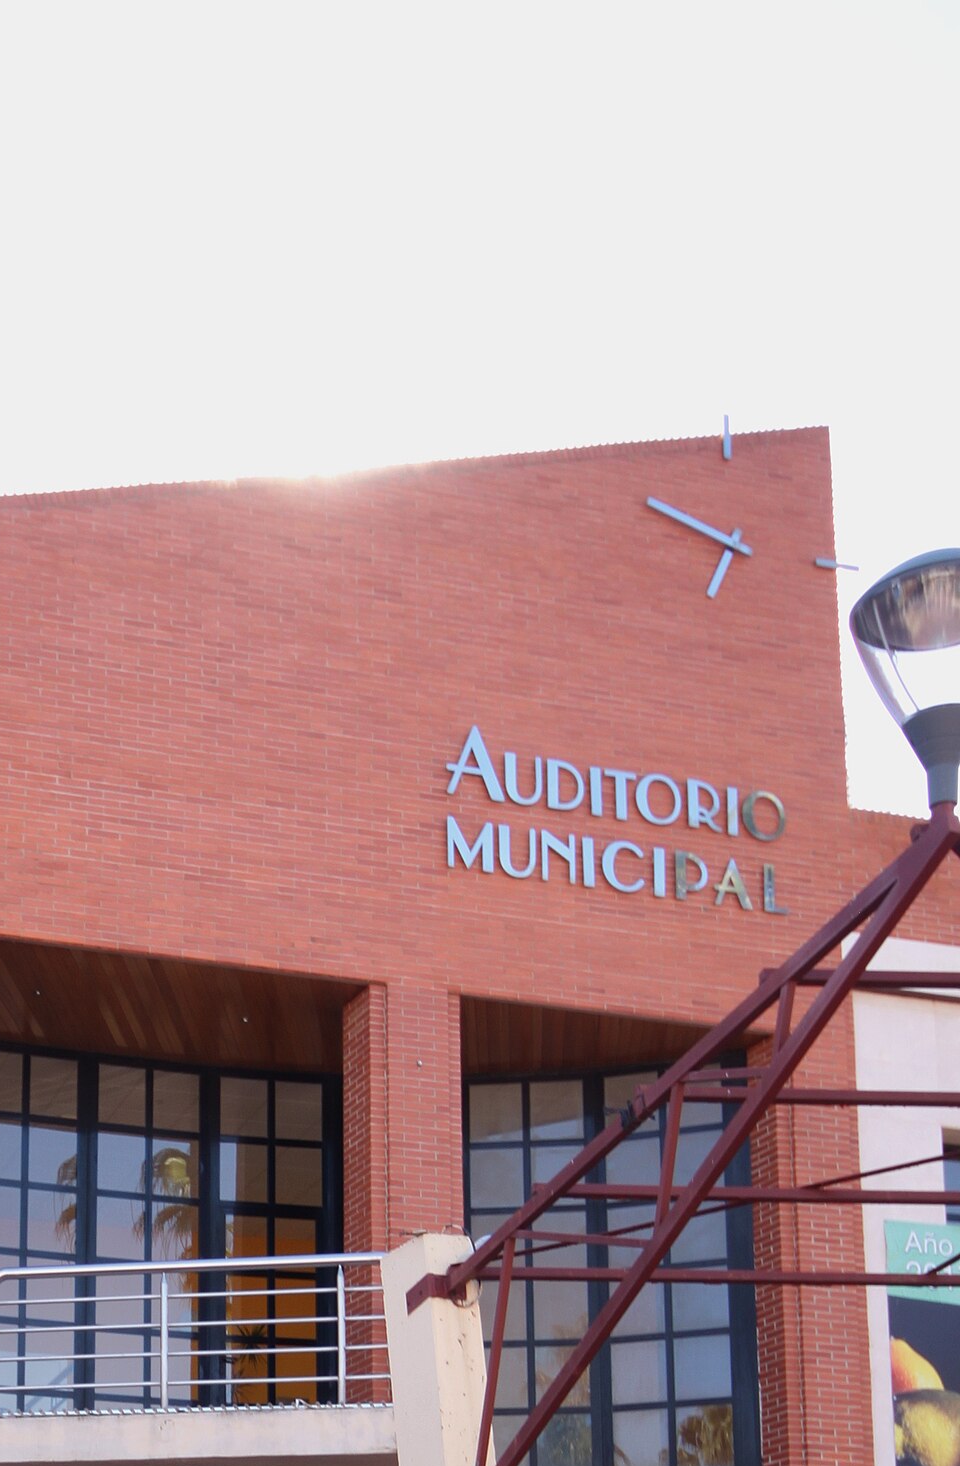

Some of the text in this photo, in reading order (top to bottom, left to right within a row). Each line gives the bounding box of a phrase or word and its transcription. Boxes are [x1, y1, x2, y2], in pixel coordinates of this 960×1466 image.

[445, 725, 786, 842] AUDITORIO
[446, 814, 789, 916] MUNICIPAL
[905, 1231, 953, 1257] Año
